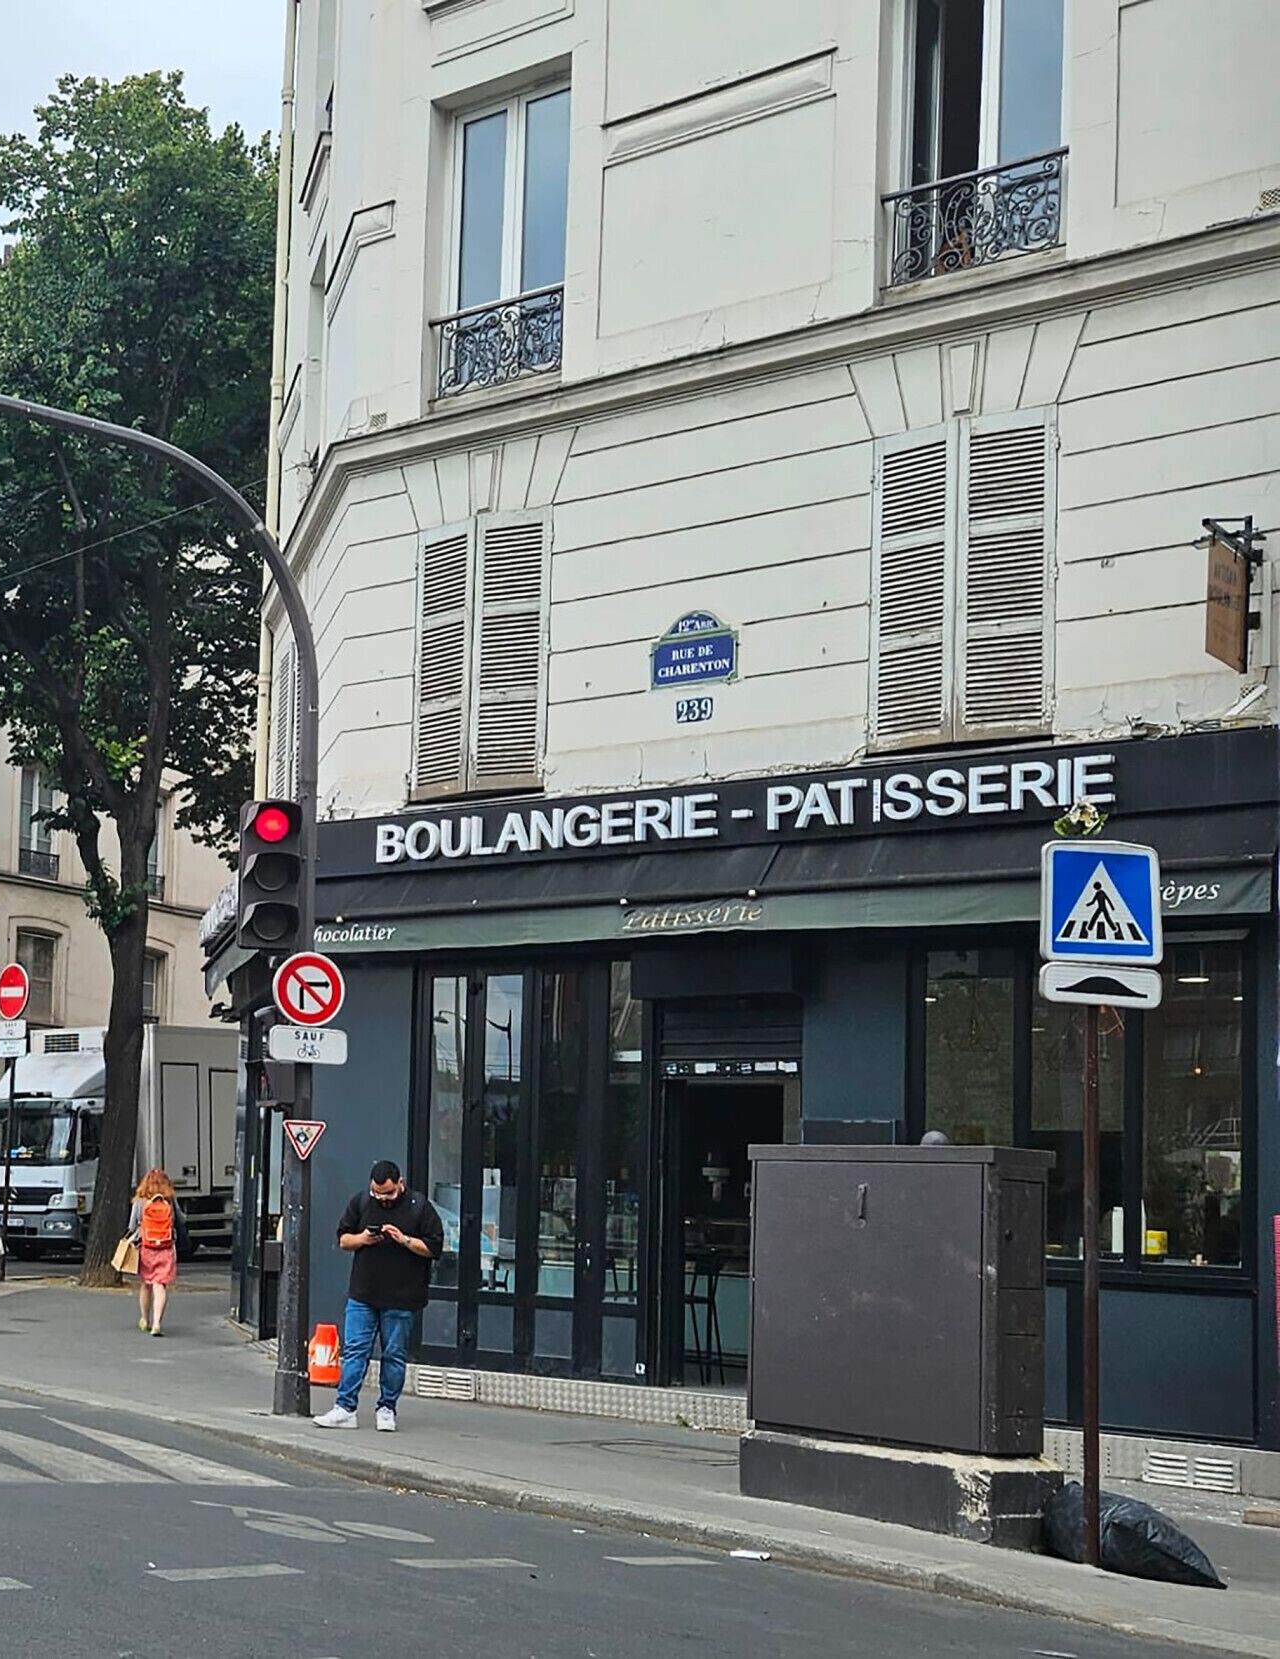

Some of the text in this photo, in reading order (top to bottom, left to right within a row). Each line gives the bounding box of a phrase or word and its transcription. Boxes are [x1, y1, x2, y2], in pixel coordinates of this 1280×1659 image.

[672, 645, 714, 661] RUE DE
[658, 658, 731, 678] CHARENTON
[677, 698, 713, 722] 239
[376, 793, 718, 863] BOULANGERIE
[766, 754, 1116, 831] PATISSERIE
[1160, 880, 1221, 908] èpes
[313, 923, 396, 942] hocolatier
[294, 1030, 325, 1042] SAUF
